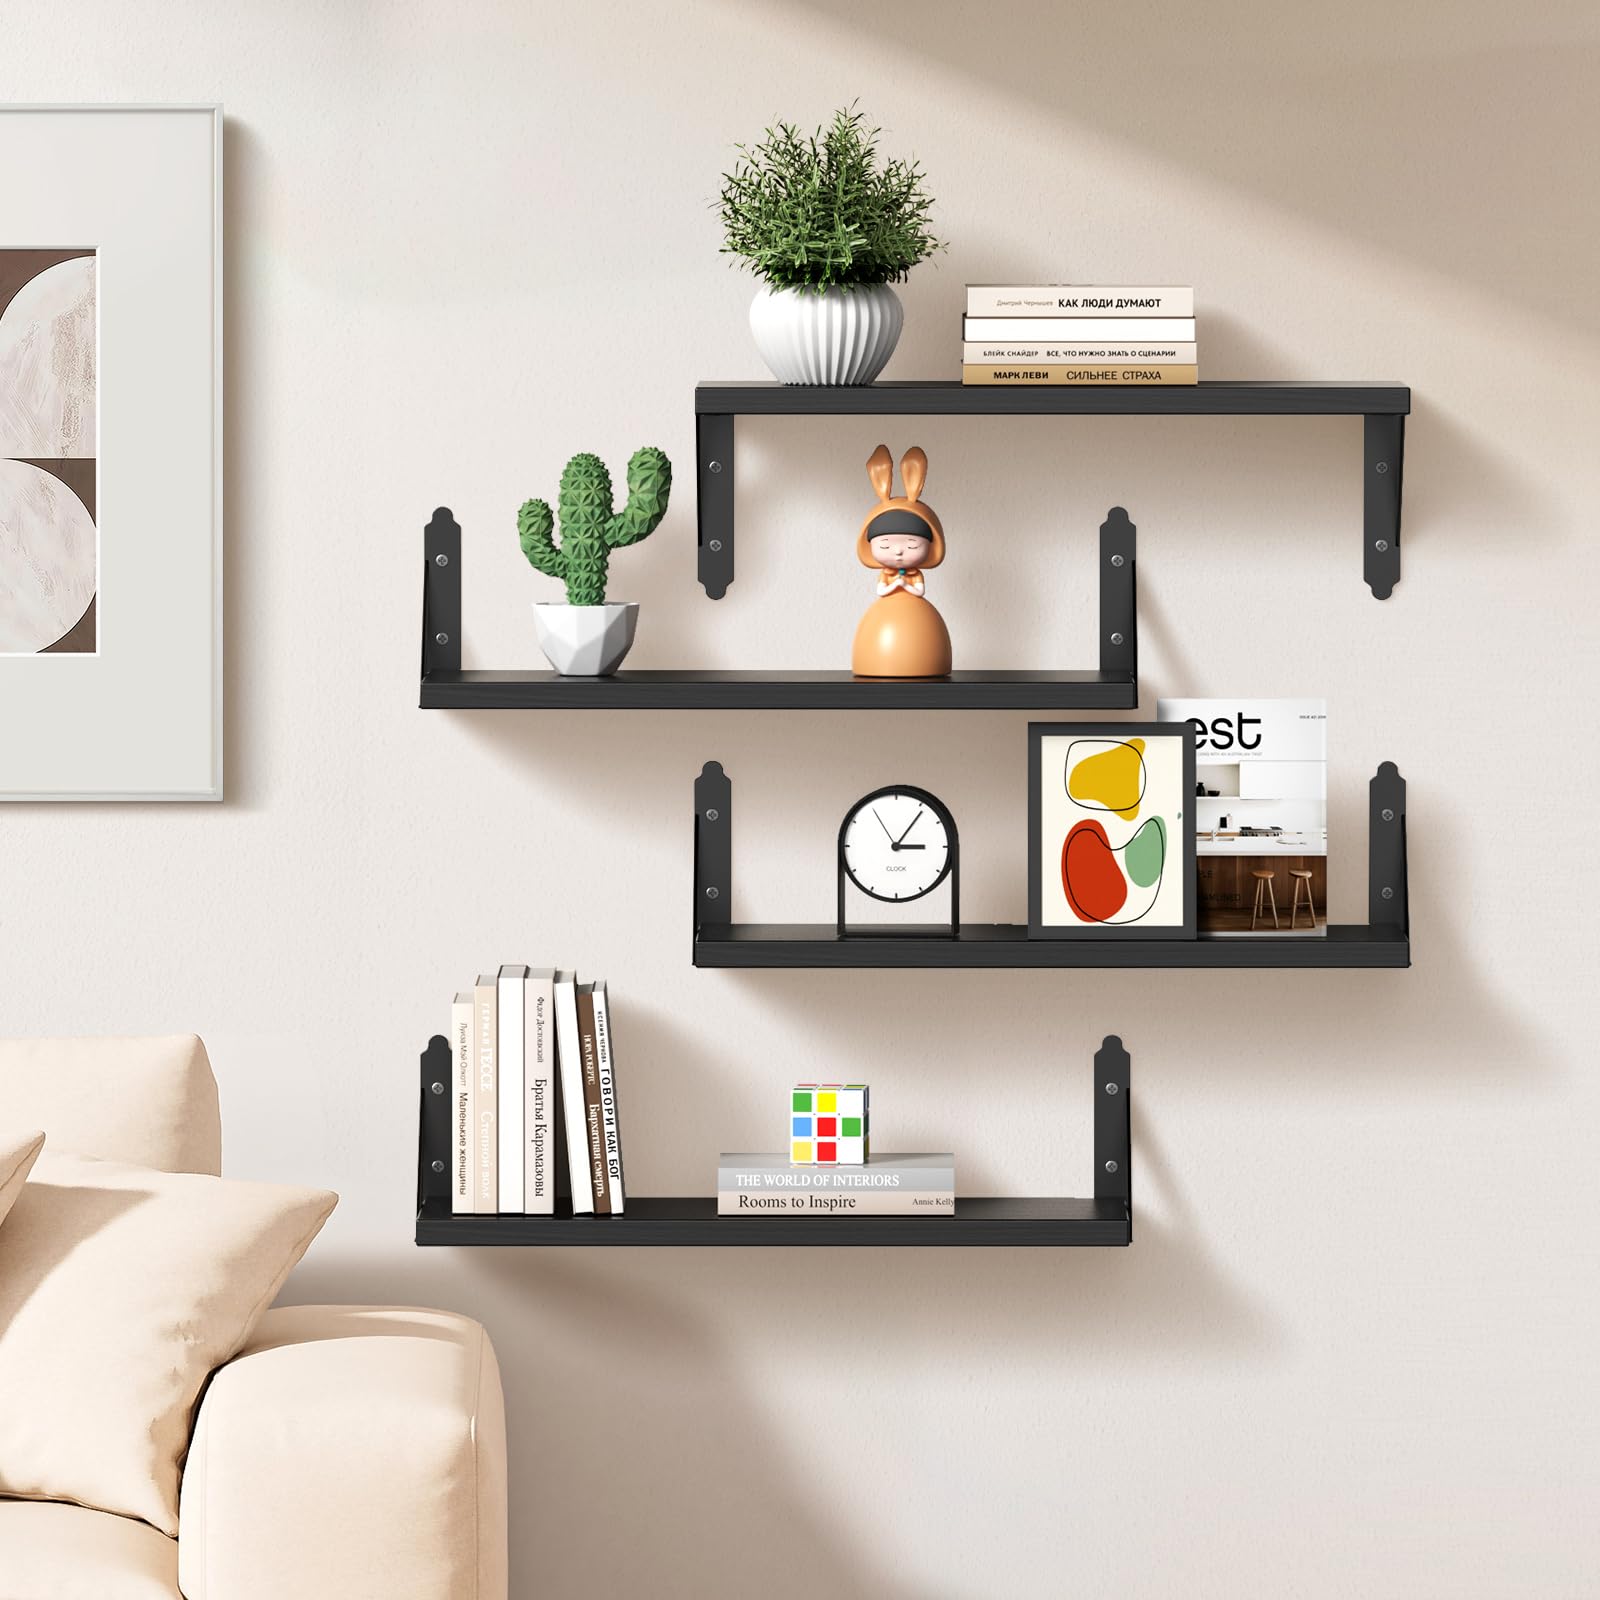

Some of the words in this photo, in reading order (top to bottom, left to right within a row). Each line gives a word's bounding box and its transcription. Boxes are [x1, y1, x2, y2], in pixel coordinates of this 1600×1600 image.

[1058, 299, 1079, 308] КАК
[1081, 299, 1113, 308] ЛЮДИ
[1115, 299, 1162, 308] ДУМАЮТ
[1066, 371, 1117, 380] СИЛЬНЕЕ
[1122, 371, 1162, 380] СТРАХА
[481, 1047, 493, 1092] ГЕССЕ
[531, 1078, 547, 1120] Братья
[601, 1068, 614, 1126] ГОВОРИ
[459, 1092, 468, 1147] Маленькие
[588, 1104, 601, 1159] Бархатная
[480, 1111, 493, 1168] Степной
[606, 1131, 617, 1153] КАК
[458, 1149, 467, 1195] женщины
[532, 1124, 547, 1197] Карамазовы
[609, 1159, 619, 1180] БОГ
[481, 1172, 490, 1198] волк
[592, 1161, 605, 1197] смерть
[736, 1174, 760, 1186] THE
[764, 1174, 810, 1186] WORLD
[813, 1174, 829, 1186] OF
[833, 1174, 899, 1186] INTERIORS
[739, 1195, 787, 1208] Rooms
[792, 1196, 804, 1208] to
[809, 1195, 856, 1211] Inspire
[936, 1198, 955, 1207] Kelly
